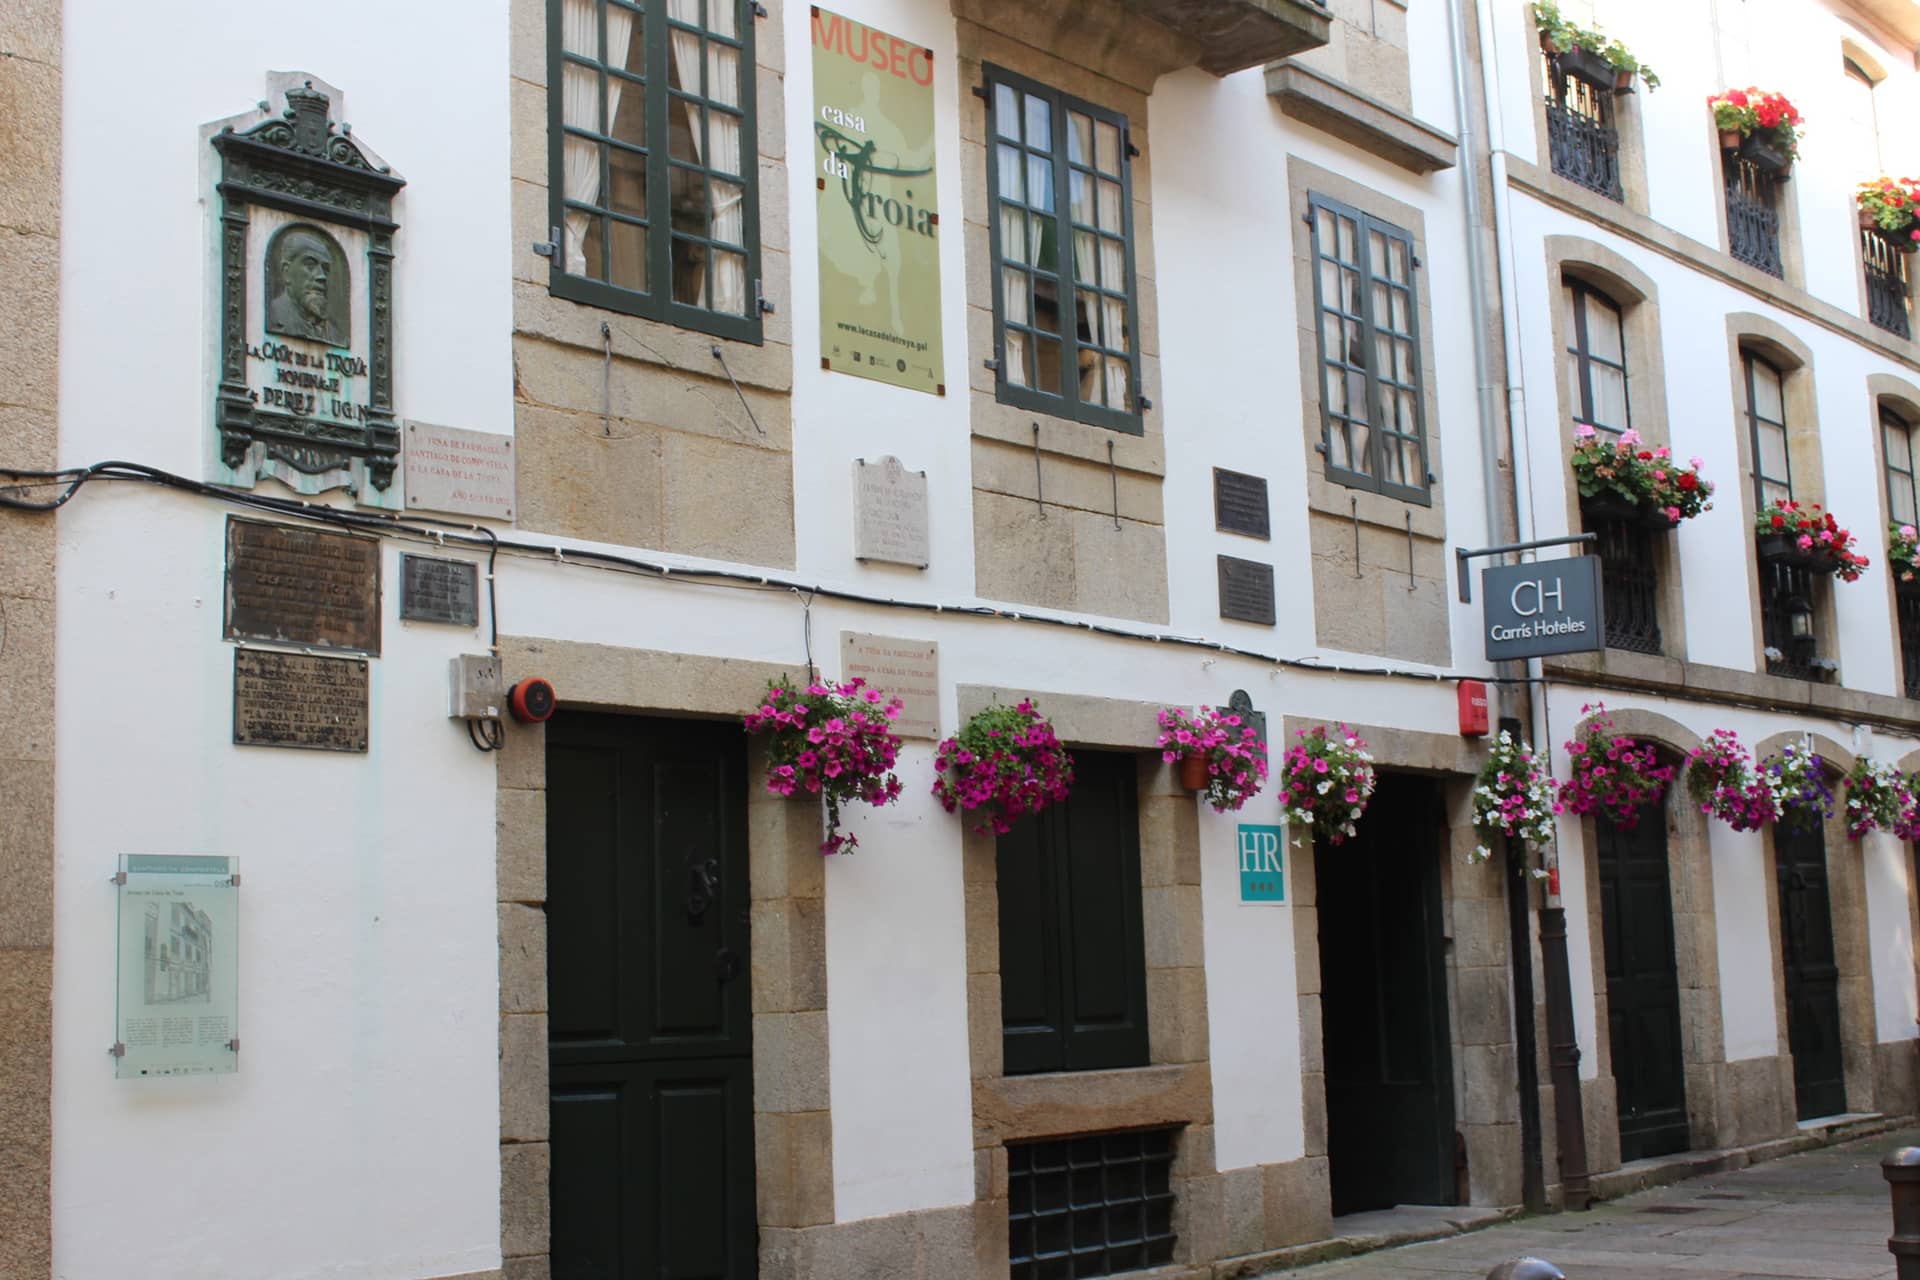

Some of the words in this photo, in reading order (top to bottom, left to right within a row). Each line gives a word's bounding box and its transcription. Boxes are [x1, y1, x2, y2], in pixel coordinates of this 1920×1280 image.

[812, 15, 933, 87] MUSEO
[821, 104, 866, 134] casa
[823, 150, 849, 181] da
[325, 352, 368, 378] TROYA
[1511, 577, 1563, 616] CH
[1490, 622, 1533, 642] Carrís
[1534, 616, 1587, 637] Hoteles
[1239, 831, 1282, 872] HR
